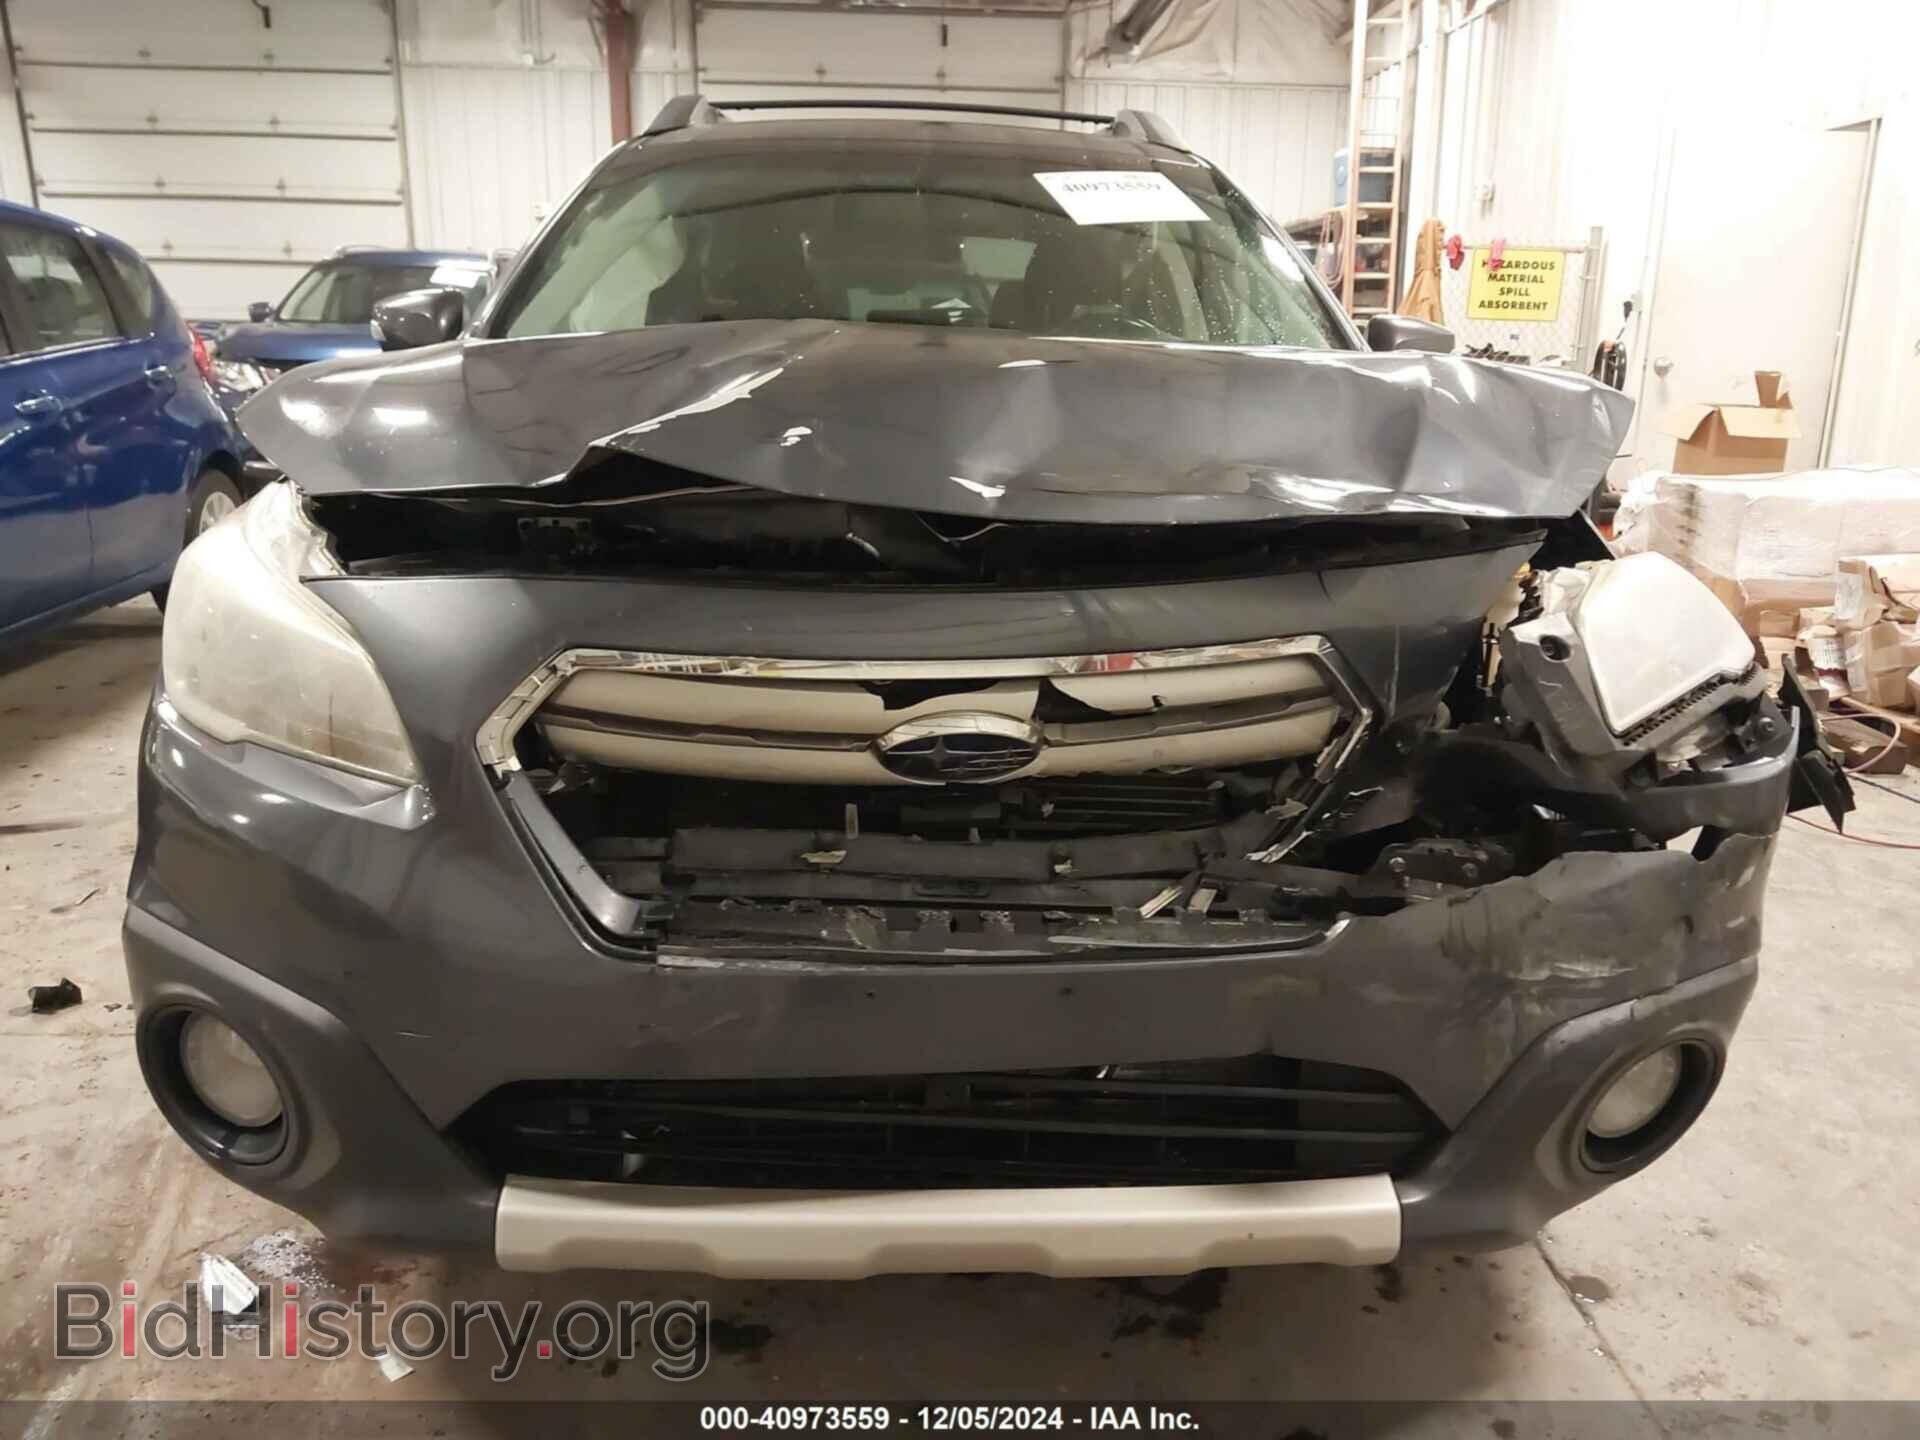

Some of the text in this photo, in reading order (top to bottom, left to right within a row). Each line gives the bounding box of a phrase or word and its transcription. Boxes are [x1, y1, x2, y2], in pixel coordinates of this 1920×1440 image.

[1482, 259, 1556, 271] HZARDOUS
[1487, 273, 1545, 284] MATERIAL
[1498, 287, 1531, 297] SPILL
[1478, 300, 1549, 311] ABSORBENT
